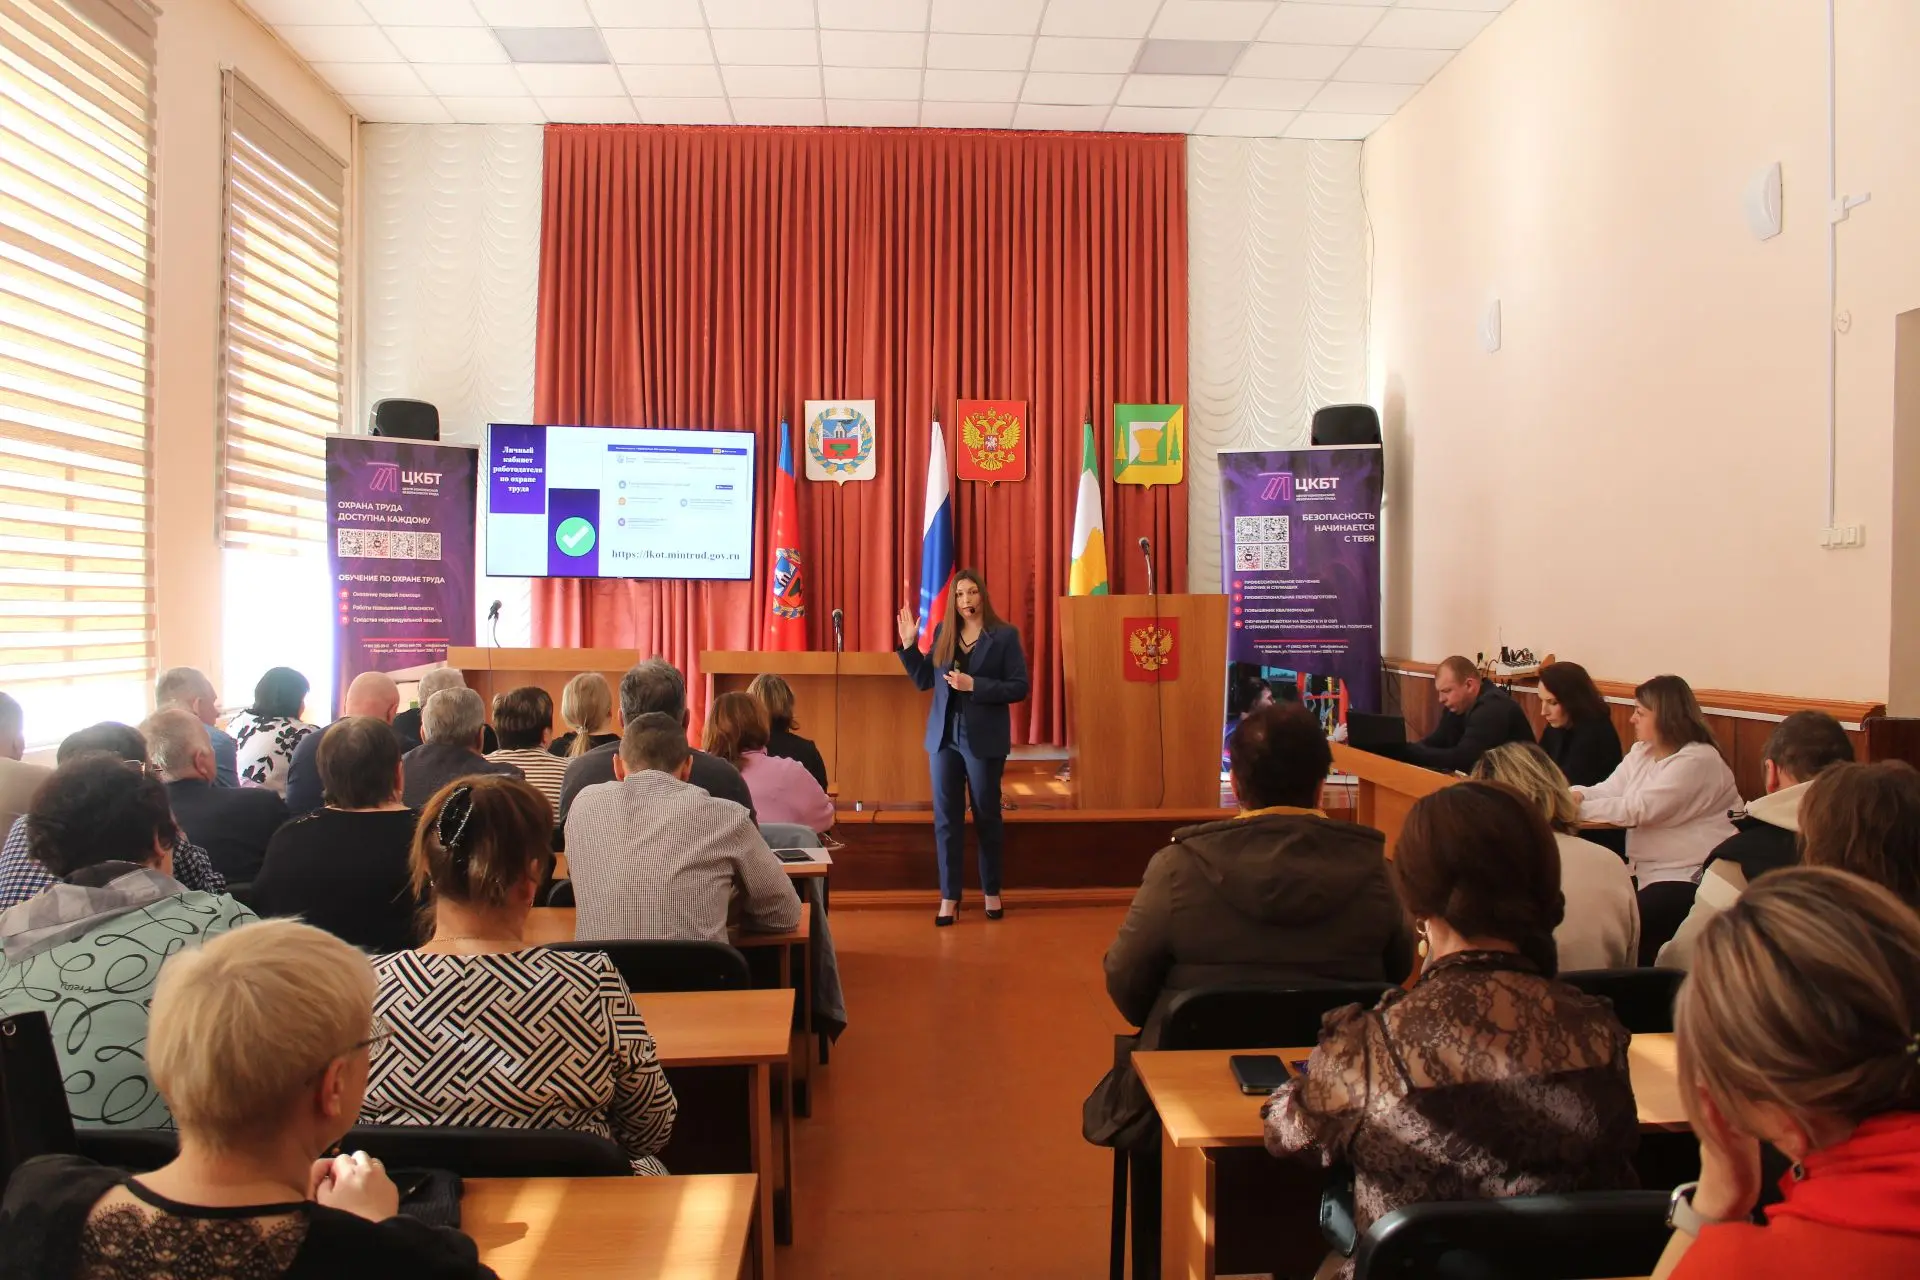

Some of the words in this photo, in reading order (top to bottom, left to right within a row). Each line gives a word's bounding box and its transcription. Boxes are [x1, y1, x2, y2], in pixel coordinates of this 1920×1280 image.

[502, 446, 534, 454] Личный
[502, 456, 533, 464] кабинет
[493, 465, 543, 473] работодателя
[402, 471, 442, 485] ЦКБТ
[510, 476, 536, 484] охране
[1295, 477, 1339, 491] ЦКБТ
[508, 486, 530, 494] труда
[338, 501, 373, 510] ОХРАНА
[375, 503, 403, 512] ТРУДА
[338, 513, 385, 522] ДОСТУПНА
[387, 515, 431, 525] КАЖДОМУ
[1302, 513, 1375, 521] БЕЗОПАСНОСТЬ
[1314, 524, 1375, 532] НАЧИНАЕТСЯ
[1353, 535, 1375, 543] ТЕБЯ
[612, 549, 740, 561] https://lkot.mintrud.gov.ru
[338, 574, 378, 582] ОБУЧЕНИЕ
